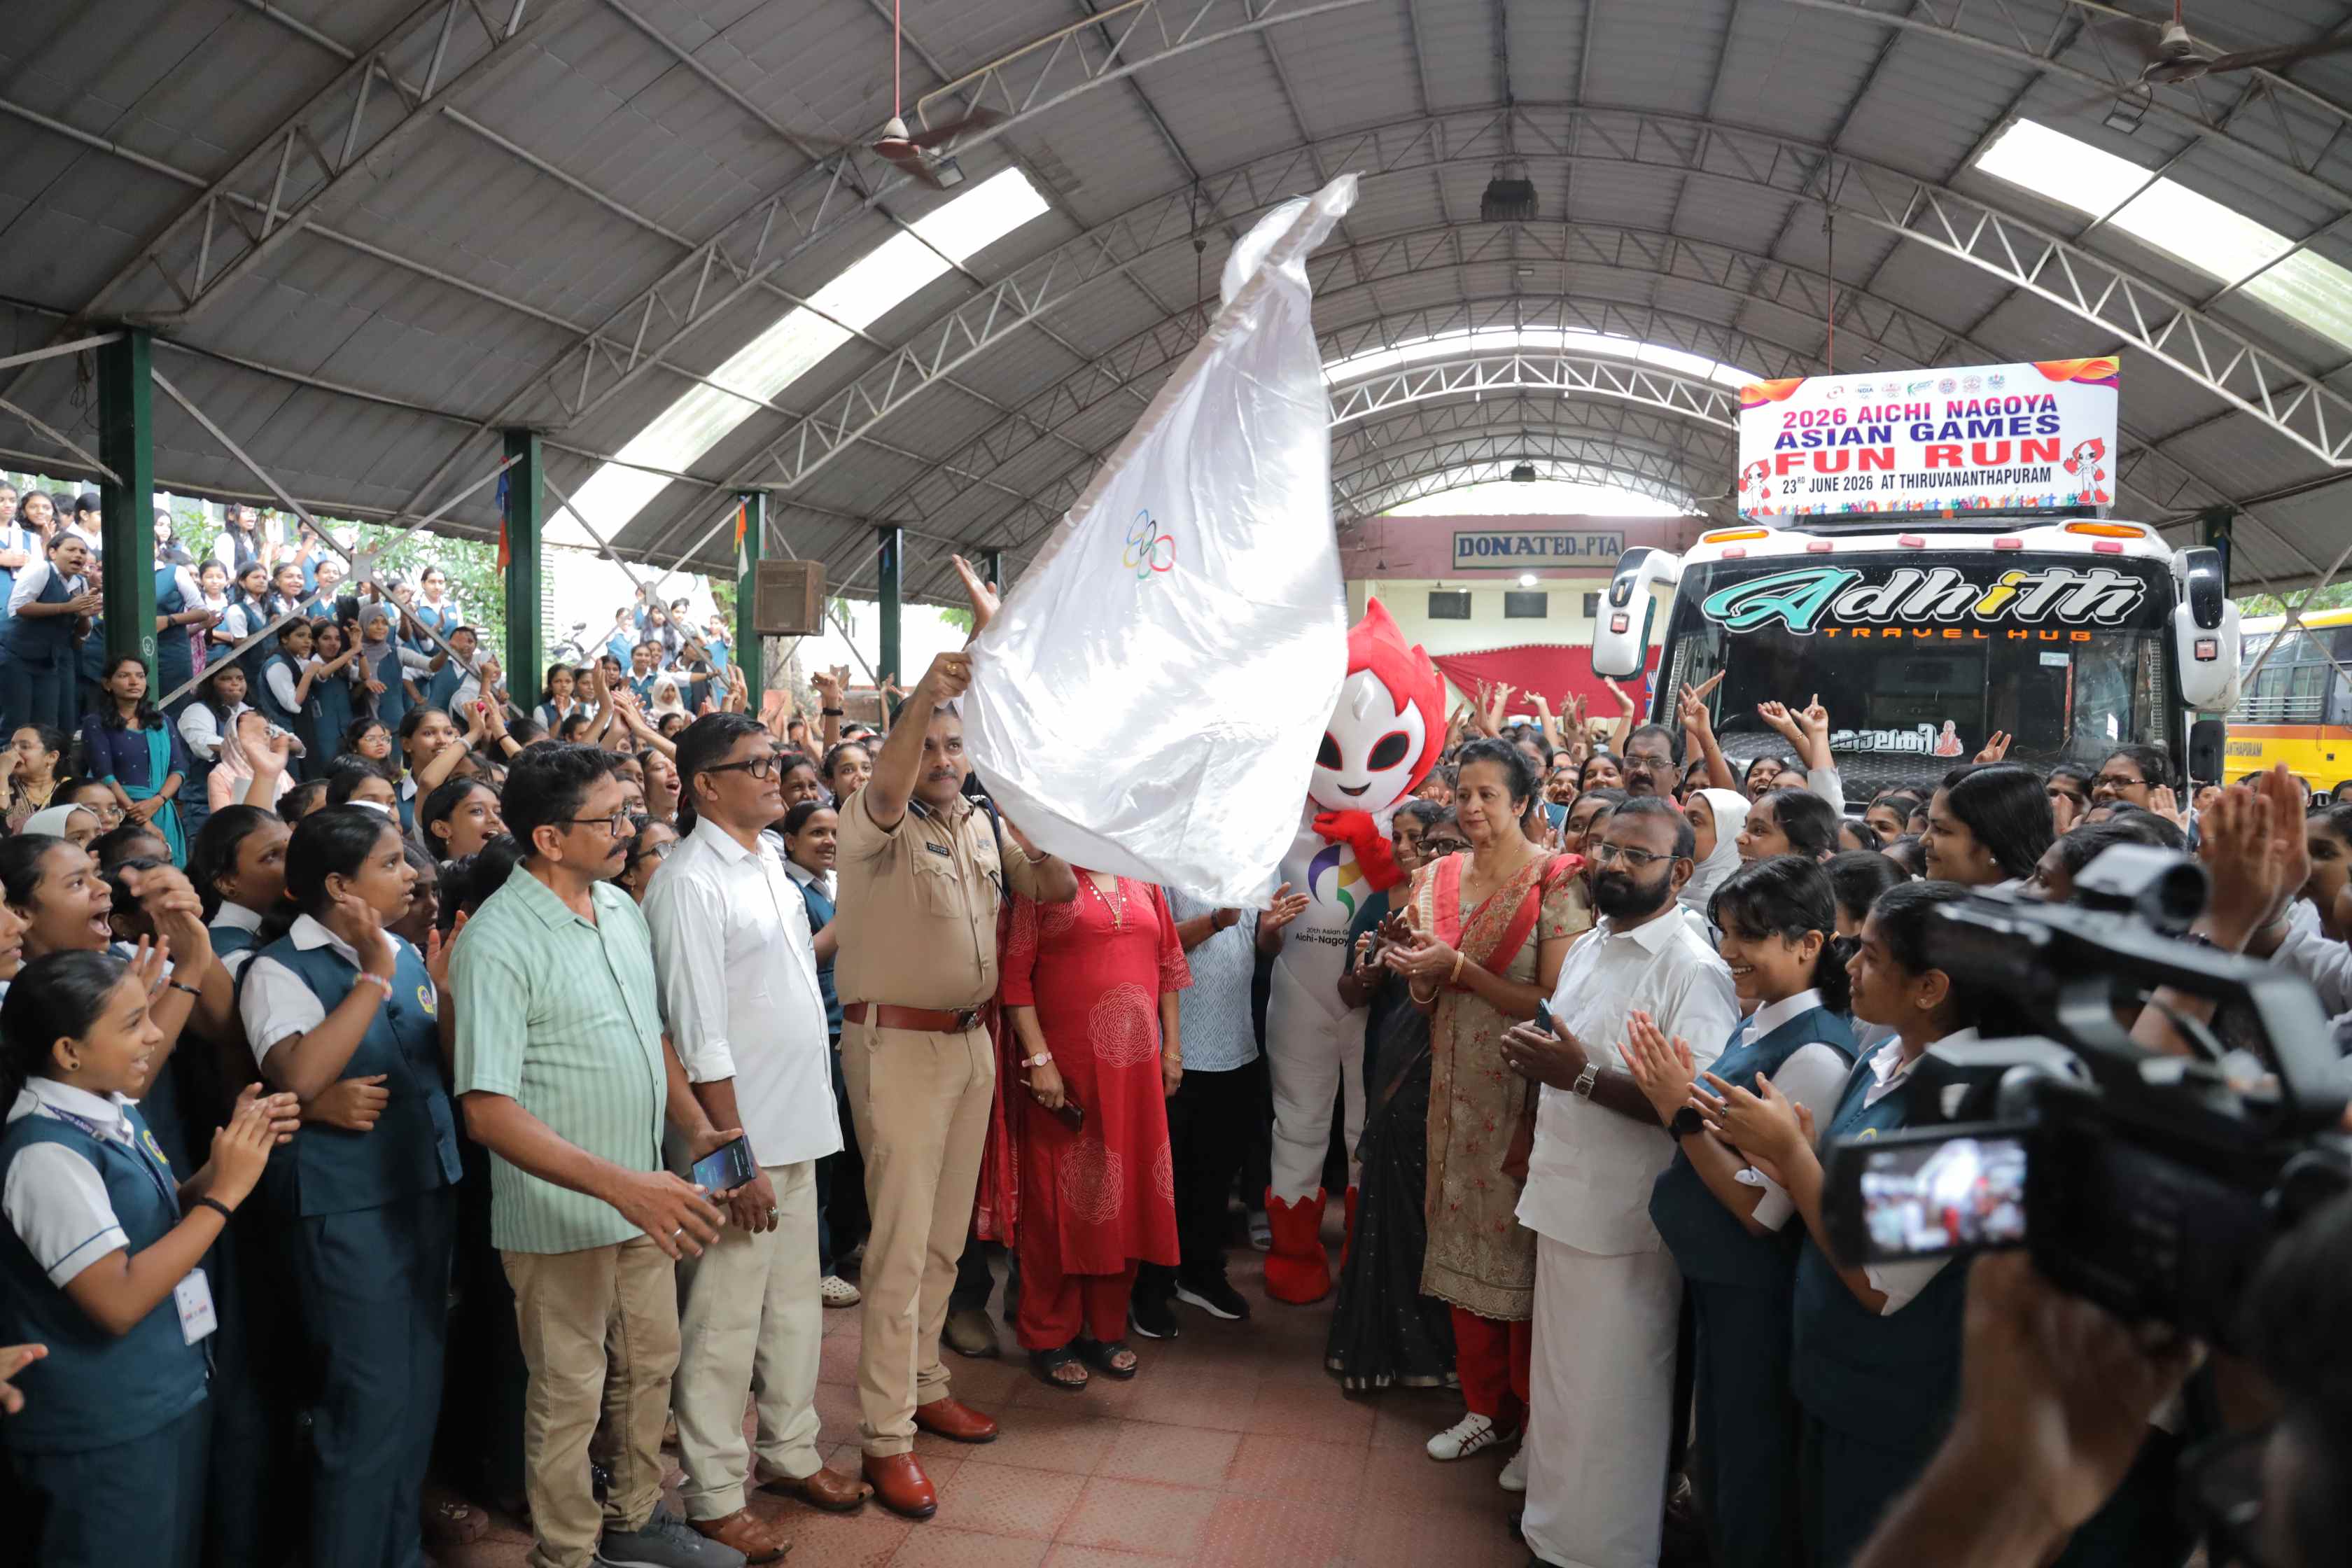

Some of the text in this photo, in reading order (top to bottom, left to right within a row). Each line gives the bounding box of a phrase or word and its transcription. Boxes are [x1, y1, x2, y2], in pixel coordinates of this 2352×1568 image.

[1783, 393, 2057, 428] 2026 AICHI NAGOYA
[1774, 414, 2060, 450] ASIAN GAMES
[1775, 438, 2061, 476] FUN RUN
[1809, 477, 1839, 493] JUNE
[1843, 475, 1873, 491] 2026
[1881, 475, 1896, 489] AT
[1900, 467, 2051, 489] THIRUVANANTHAPURAM
[1458, 536, 1620, 556] DONATED PTA
[1823, 627, 2091, 641] TRAVEL HUB
[1295, 932, 1349, 946] Aichi-Nagoy
